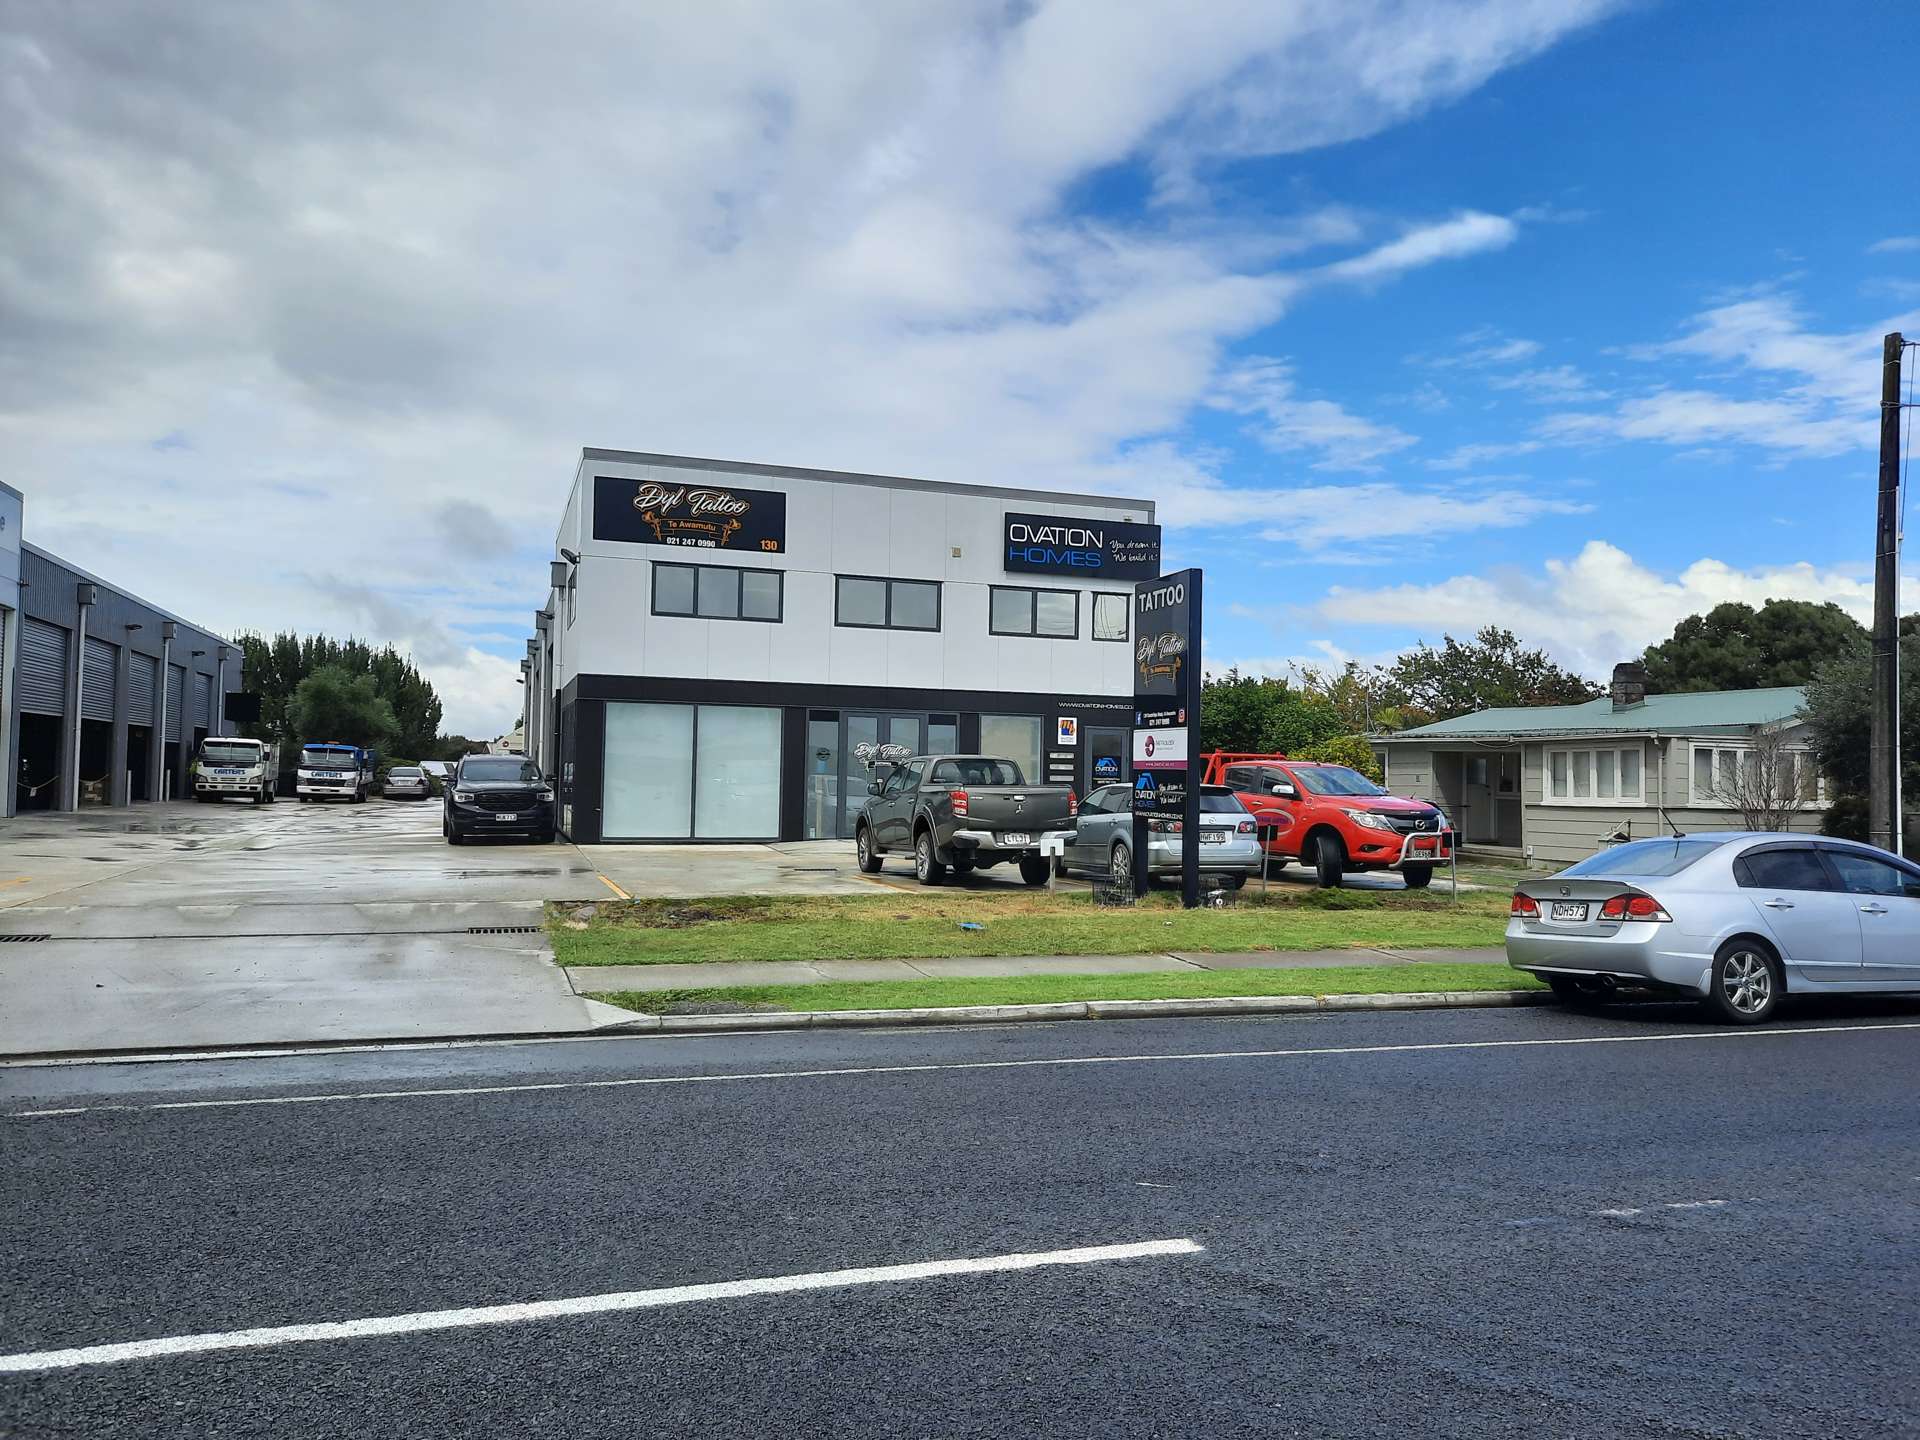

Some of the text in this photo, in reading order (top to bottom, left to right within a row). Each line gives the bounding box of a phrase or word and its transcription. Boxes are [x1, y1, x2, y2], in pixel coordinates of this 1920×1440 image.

[633, 483, 750, 517] Dyl Tattoo
[668, 520, 716, 532] Te Awamutu
[666, 536, 716, 548] 021 247 0990
[1009, 523, 1103, 548] OVATION
[760, 540, 778, 551] 130
[1127, 540, 1150, 549] dream
[1009, 547, 1102, 567] HOMES
[1128, 552, 1147, 562] build
[1138, 583, 1184, 613] TATTOO
[1157, 633, 1185, 660] Tattoo
[880, 744, 912, 760] Tattoo
[1135, 790, 1156, 800] OVATION
[1553, 903, 1586, 917] NDH573
